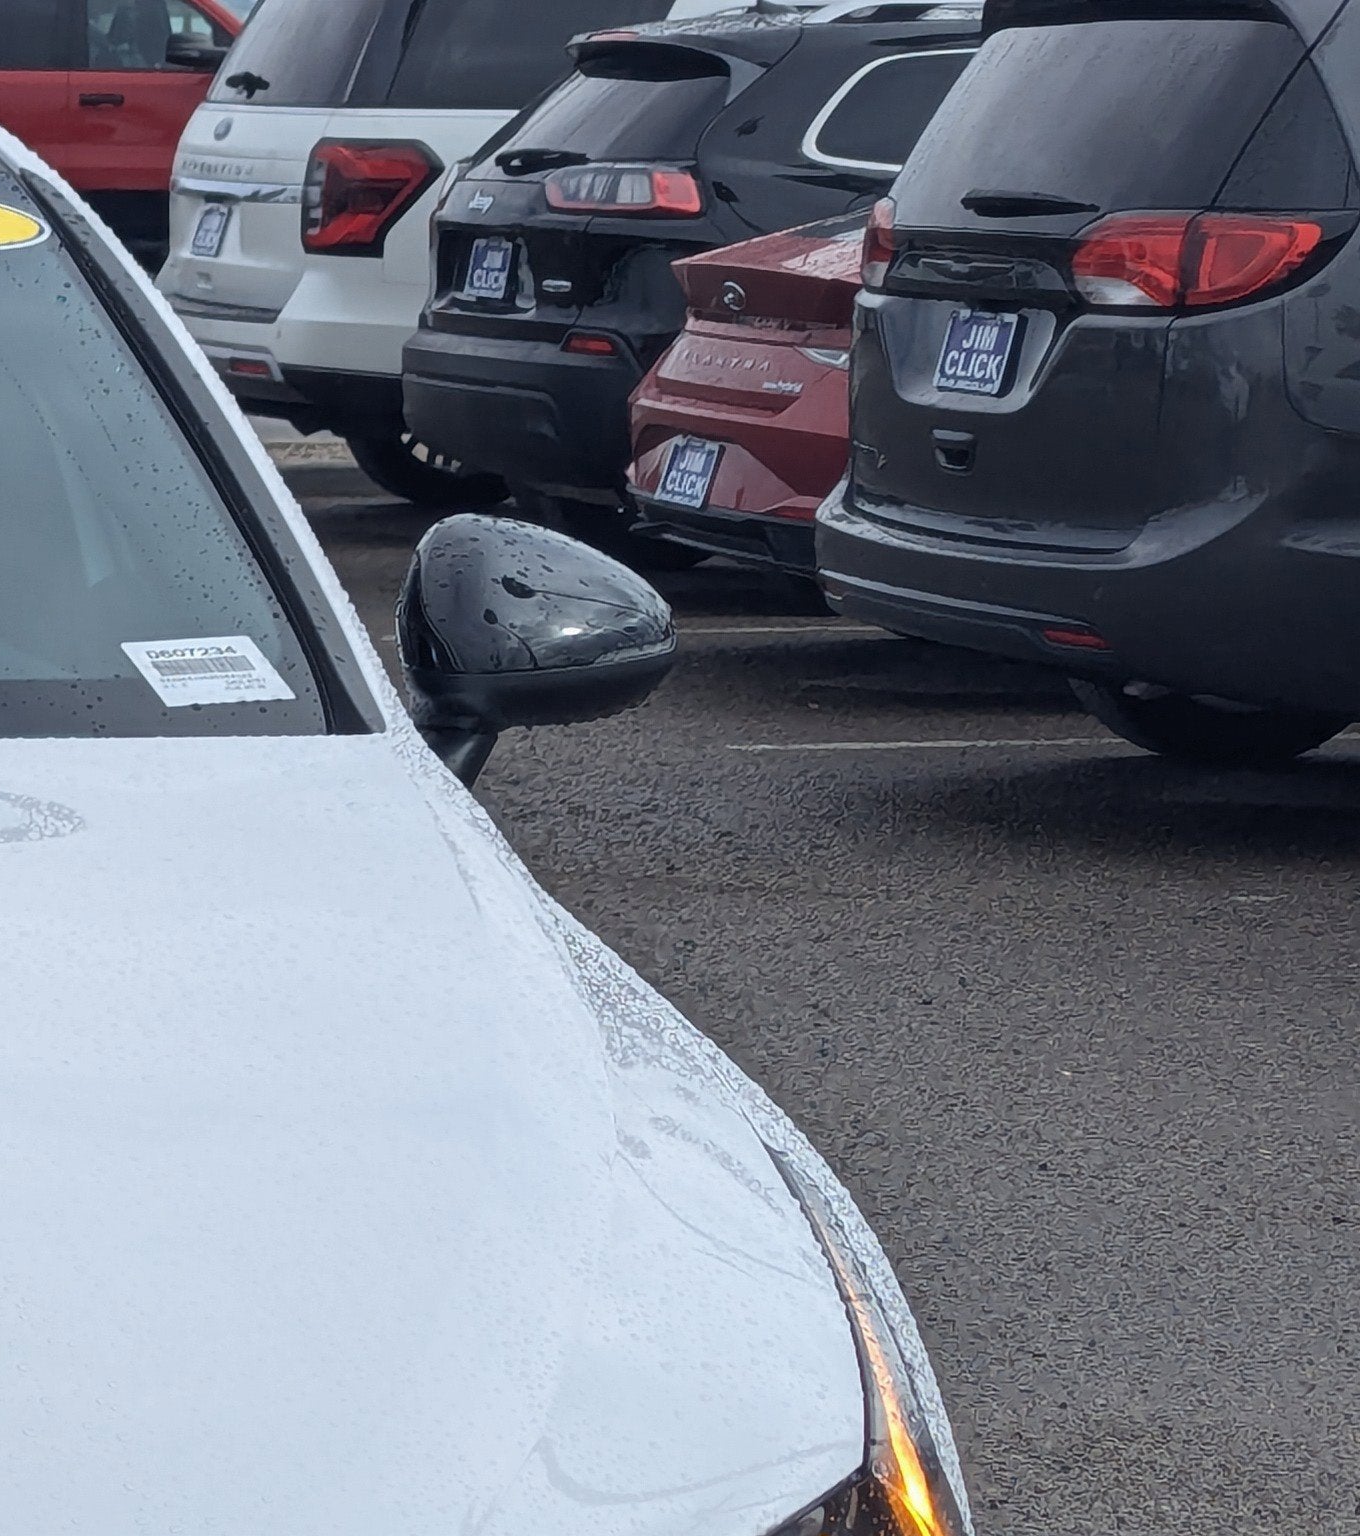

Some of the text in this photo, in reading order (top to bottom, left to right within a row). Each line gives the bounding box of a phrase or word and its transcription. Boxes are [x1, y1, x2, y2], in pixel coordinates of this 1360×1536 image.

[962, 324, 999, 350] JIM
[945, 350, 1004, 381] CLICK
[665, 470, 708, 497] CLICK
